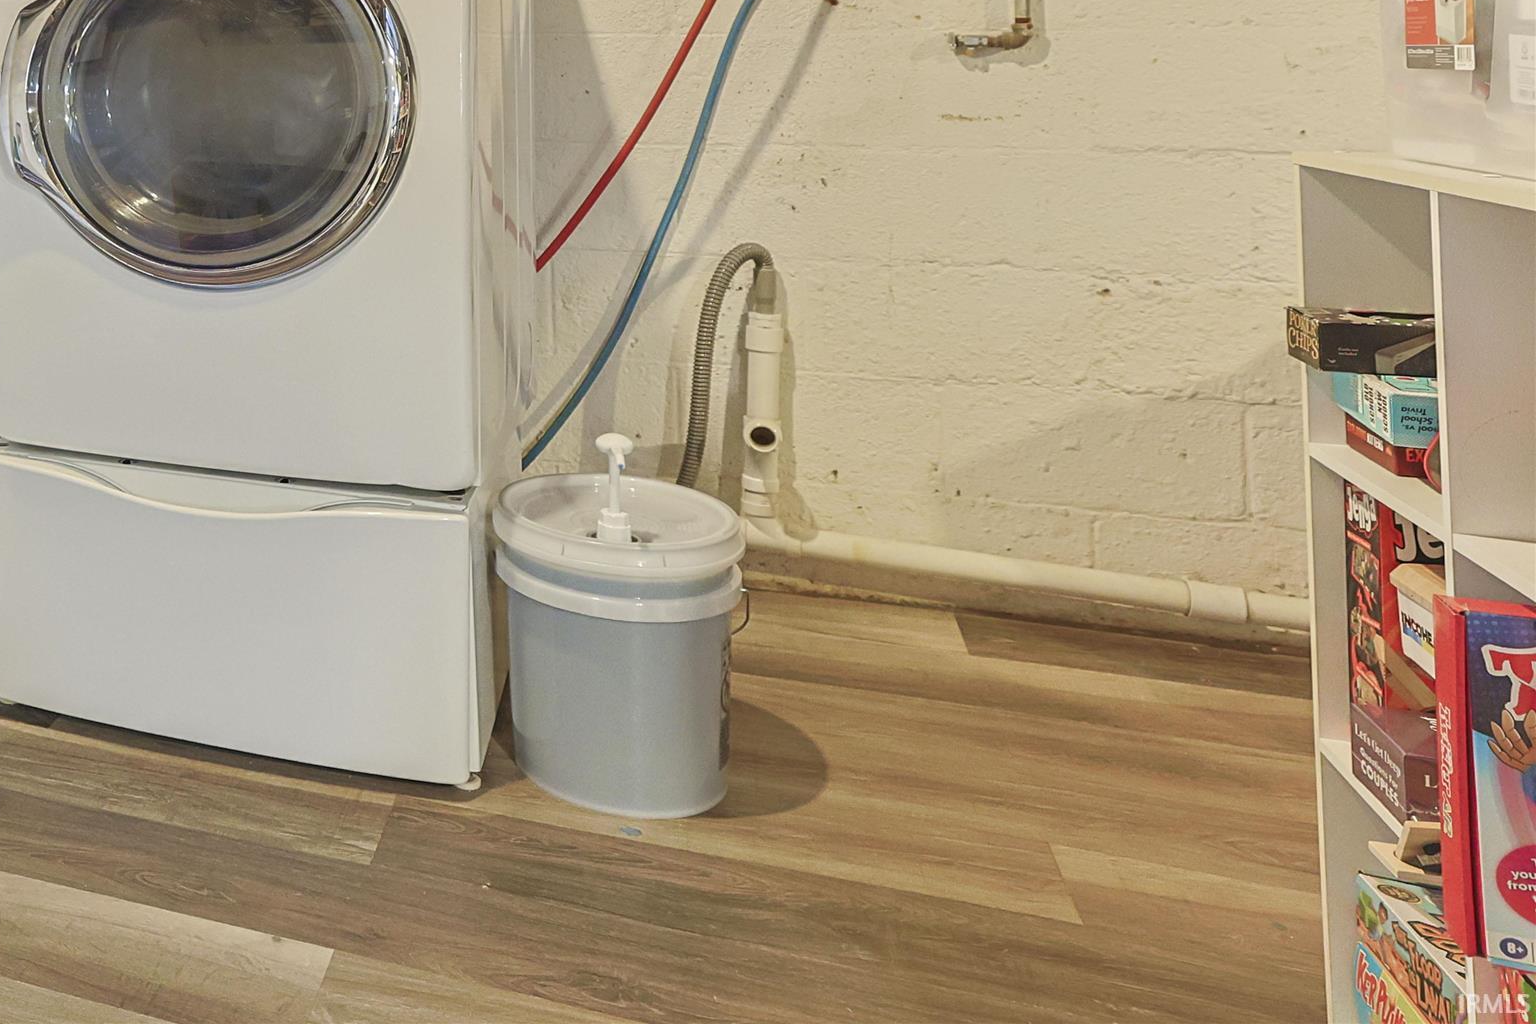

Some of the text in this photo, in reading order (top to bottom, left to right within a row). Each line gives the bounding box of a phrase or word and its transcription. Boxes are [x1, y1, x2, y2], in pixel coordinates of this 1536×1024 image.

[1288, 327, 1319, 359] CHIPS
[1400, 416, 1433, 425] School
[1401, 406, 1427, 415] Trivia
[1360, 759, 1399, 808] COUPLES
